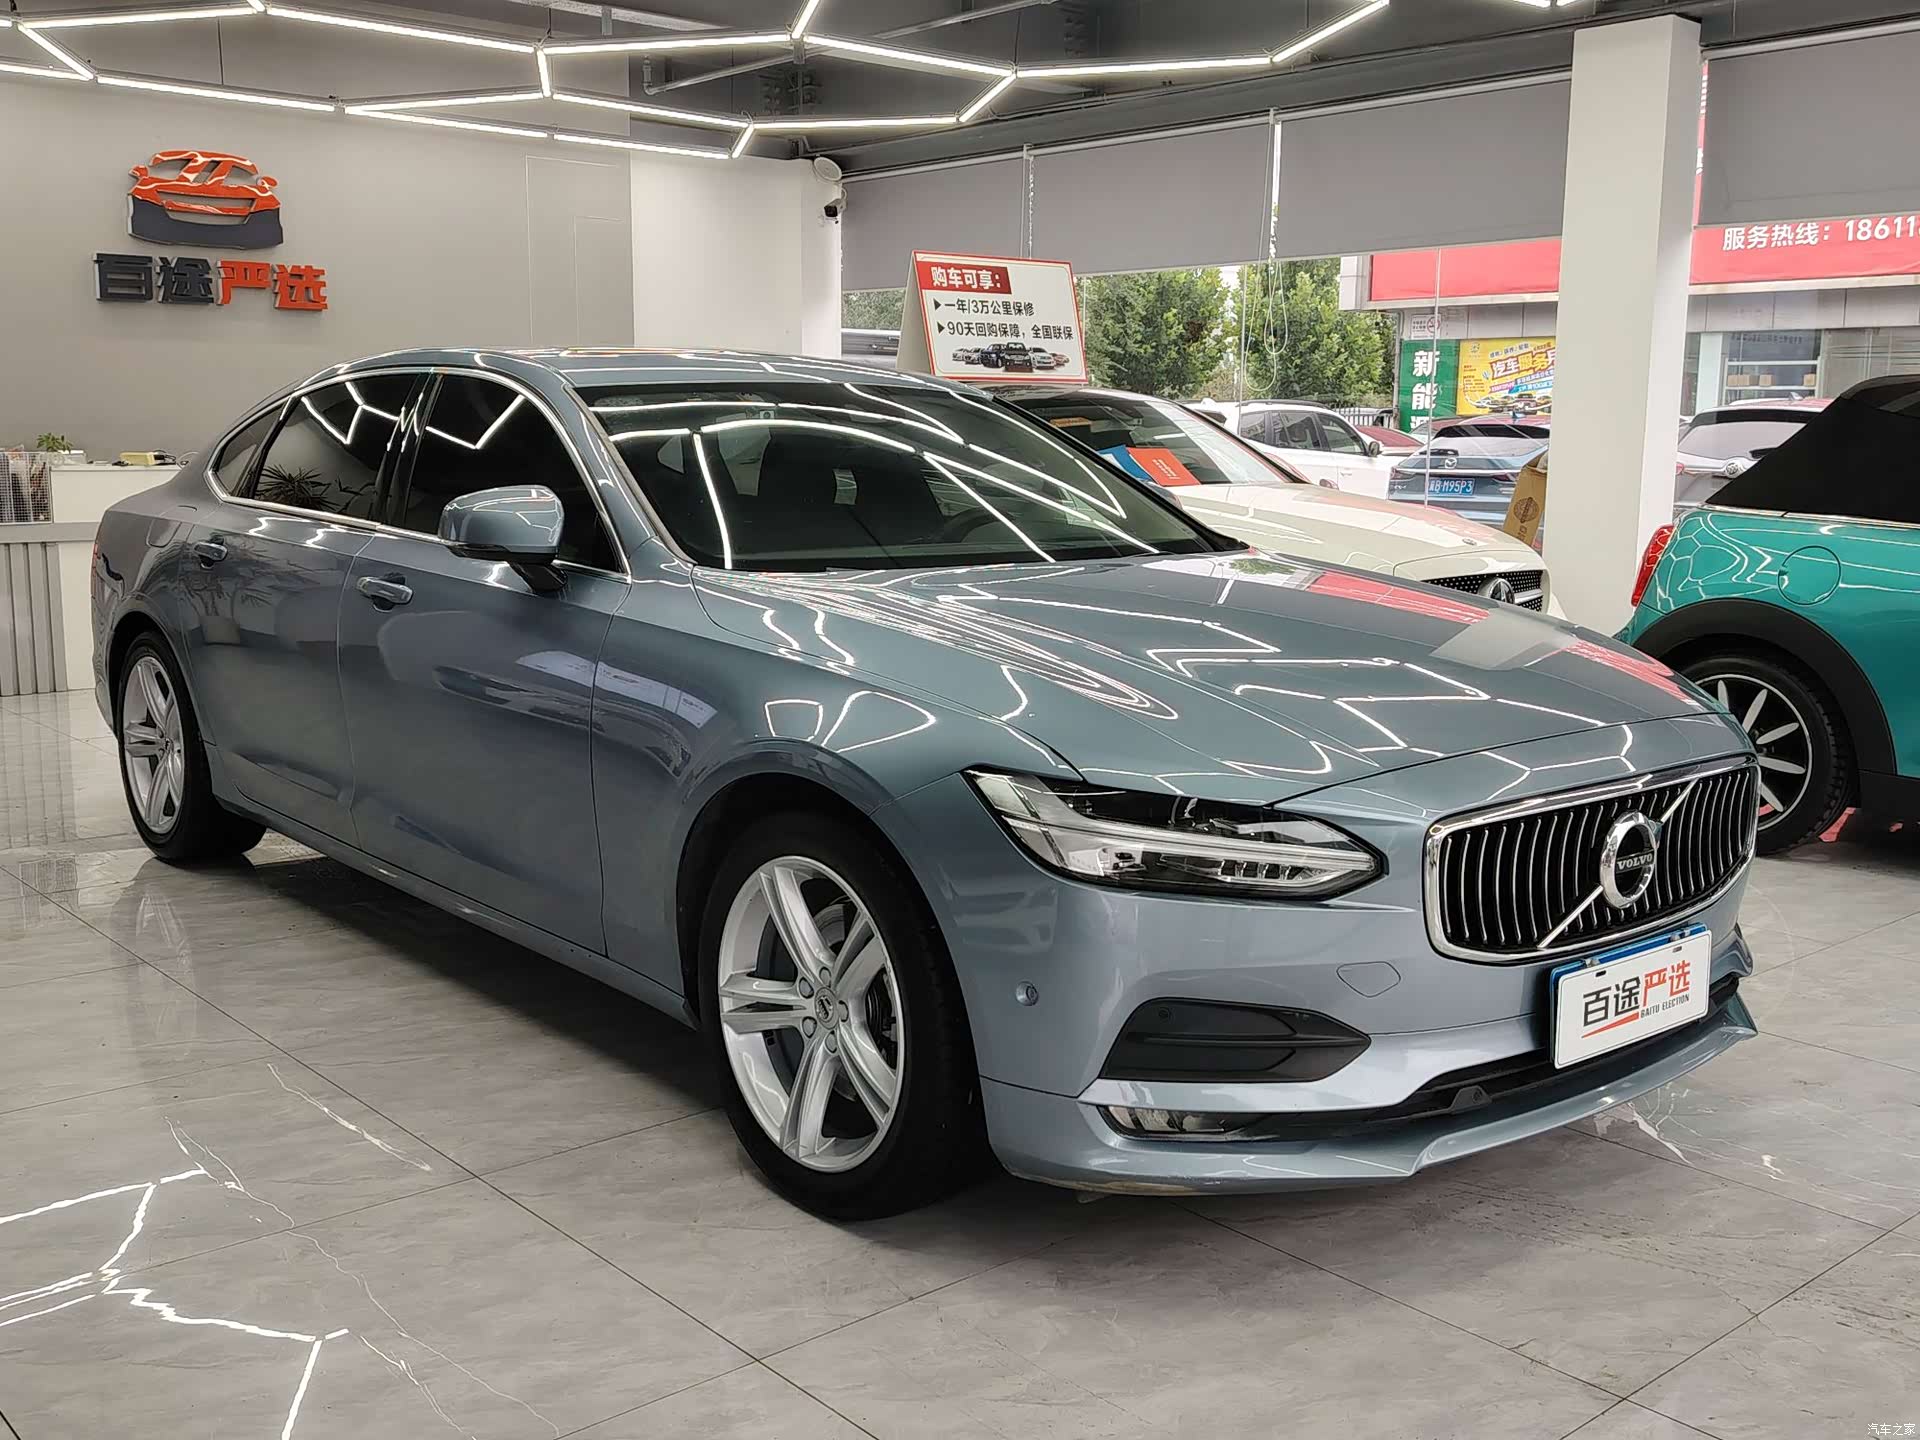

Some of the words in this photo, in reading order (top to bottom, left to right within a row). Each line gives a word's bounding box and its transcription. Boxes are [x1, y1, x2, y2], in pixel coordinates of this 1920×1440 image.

[1723, 215, 1920, 250] 服务热线：18611
[92, 252, 328, 311] 百途严选
[931, 266, 1001, 289] 购车可享：
[1617, 853, 1653, 870] VOLVO
[1583, 960, 1690, 1027] 百途严选
[1640, 1004, 1660, 1018] BAITU
[1662, 994, 1690, 1010] ELECTION
